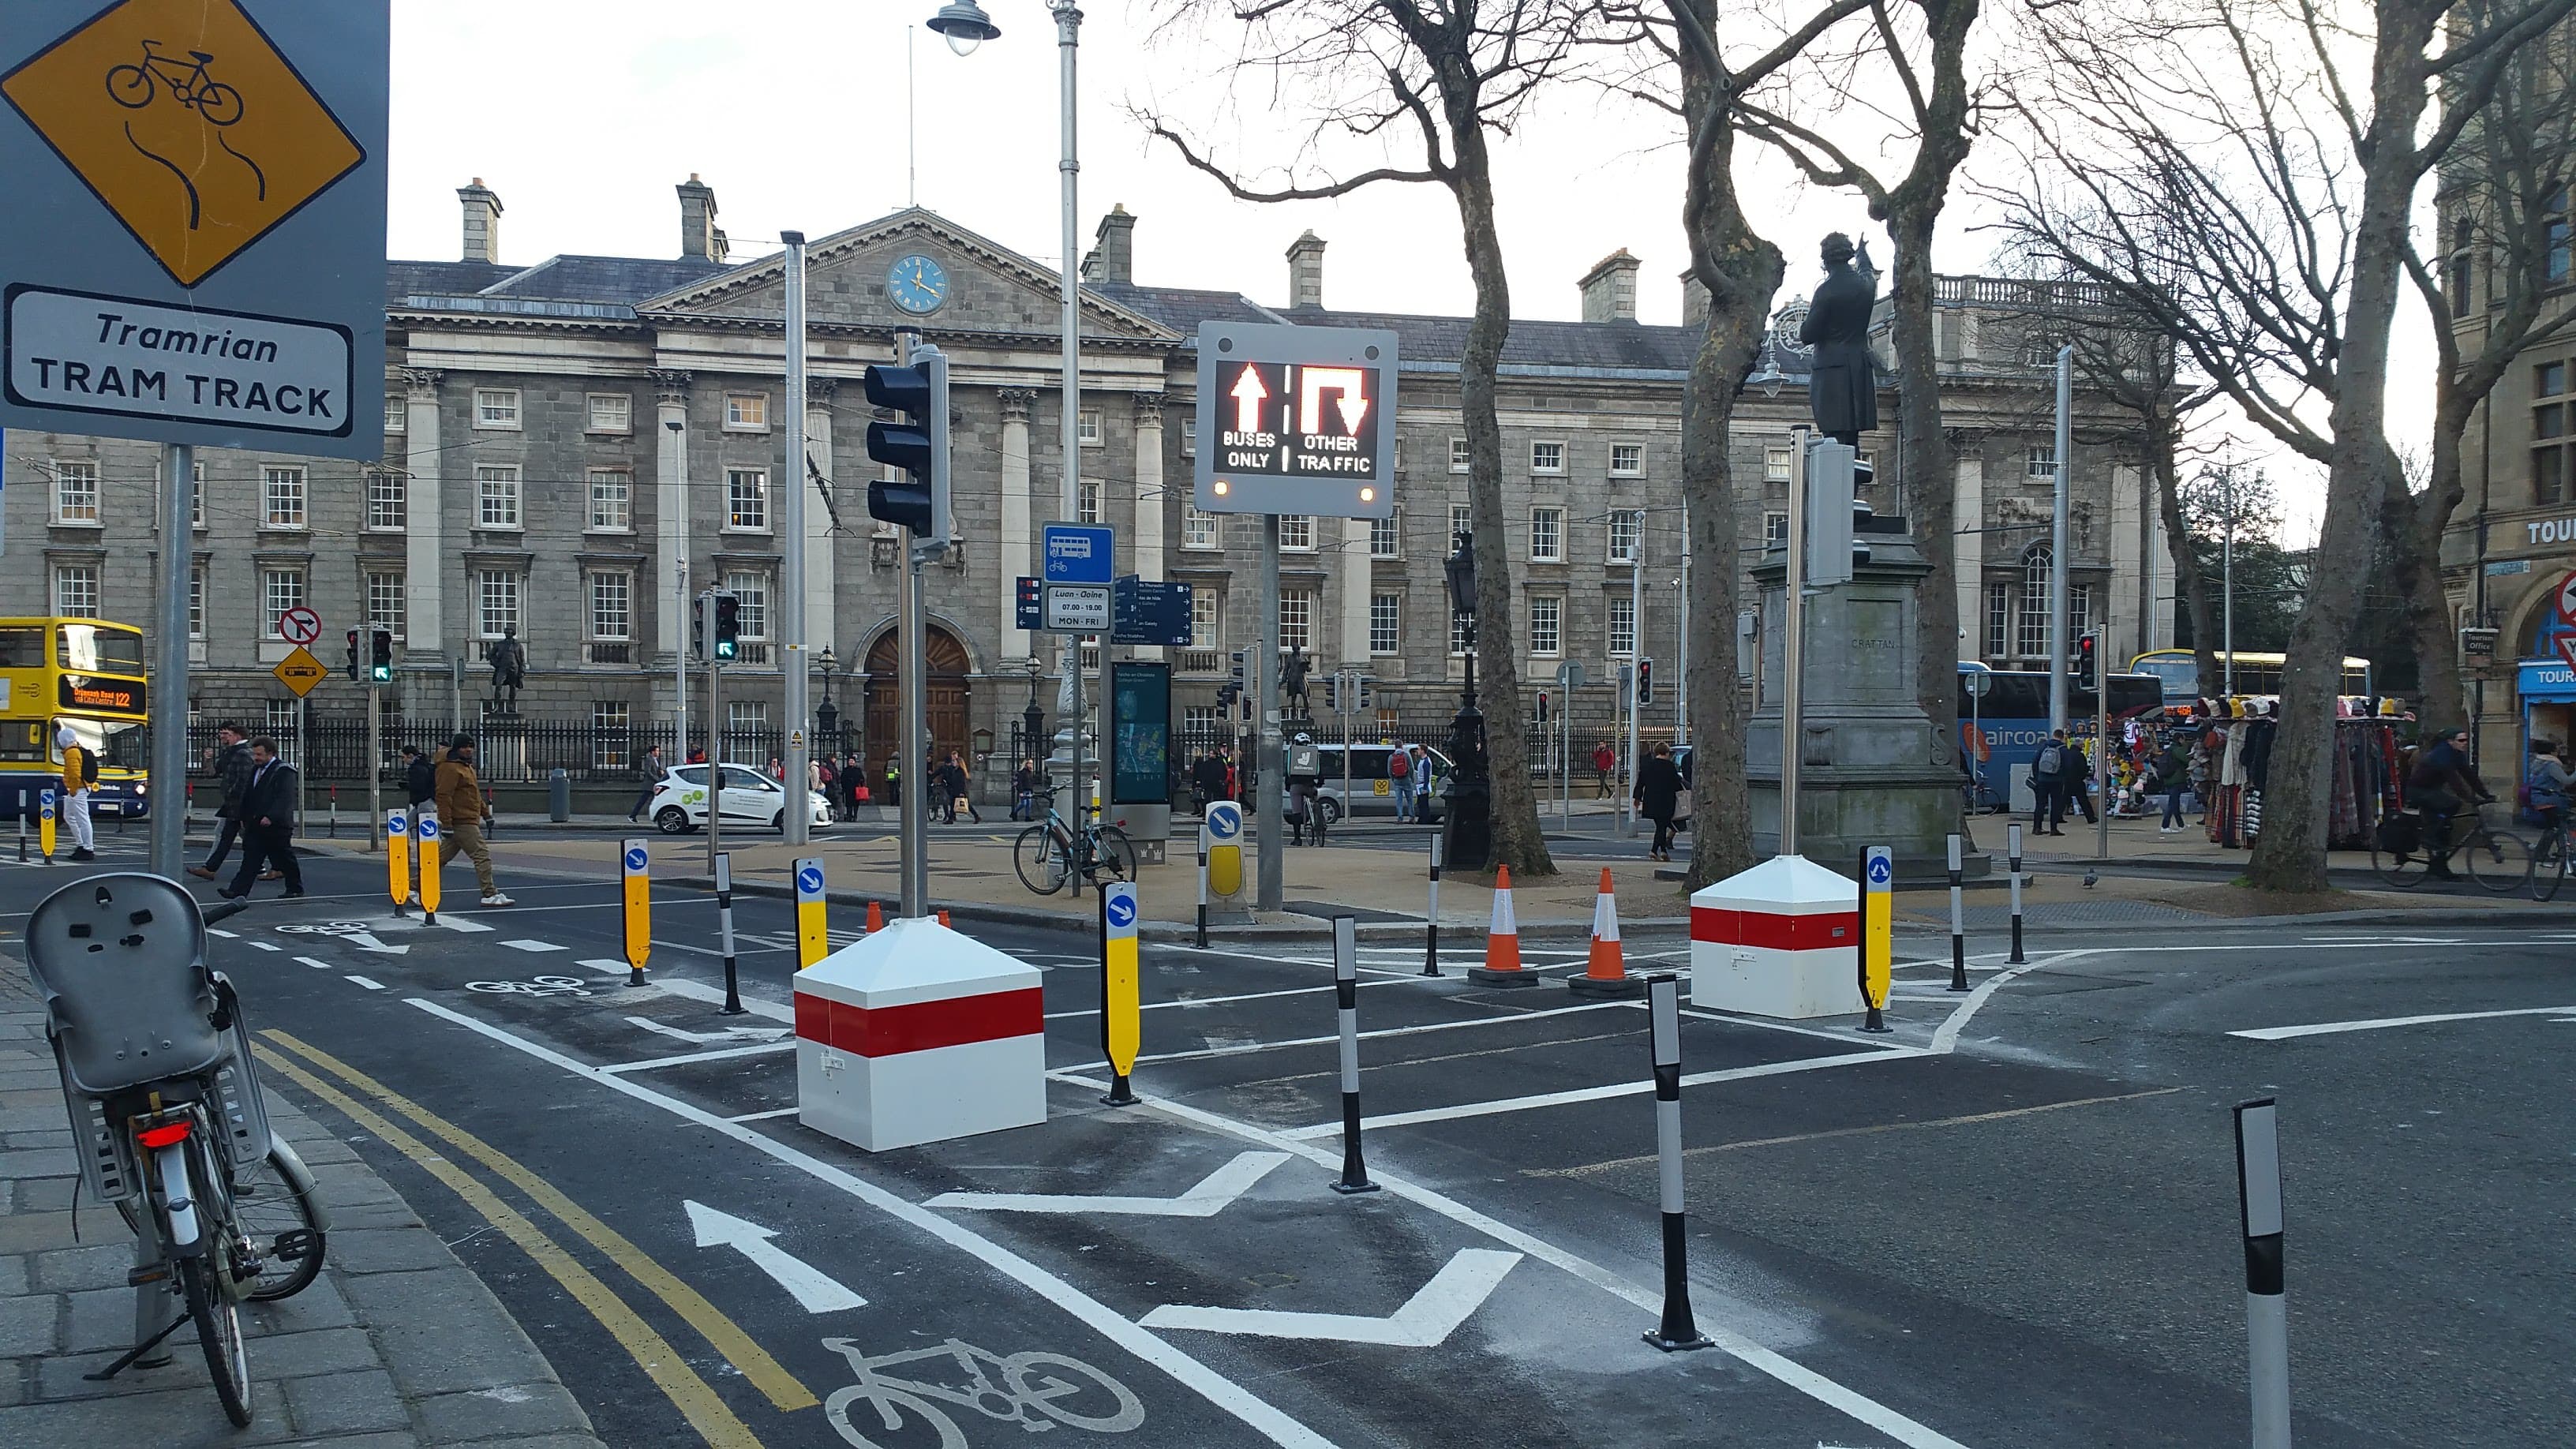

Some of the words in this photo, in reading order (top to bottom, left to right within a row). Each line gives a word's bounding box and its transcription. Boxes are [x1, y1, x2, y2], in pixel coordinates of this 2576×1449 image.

[97, 313, 279, 363] Tramrian
[31, 357, 166, 401] TRAM
[185, 375, 333, 418] TRACK
[1223, 432, 1275, 447] BUSES
[1305, 435, 1357, 451] OTHER
[1228, 452, 1269, 467] ONLY
[1297, 455, 1370, 472] TRAFFIC
[2528, 519, 2576, 544] TOU
[2537, 671, 2576, 683] TOUR
[115, 693, 129, 707] 122
[2177, 705, 2192, 716] 46A
